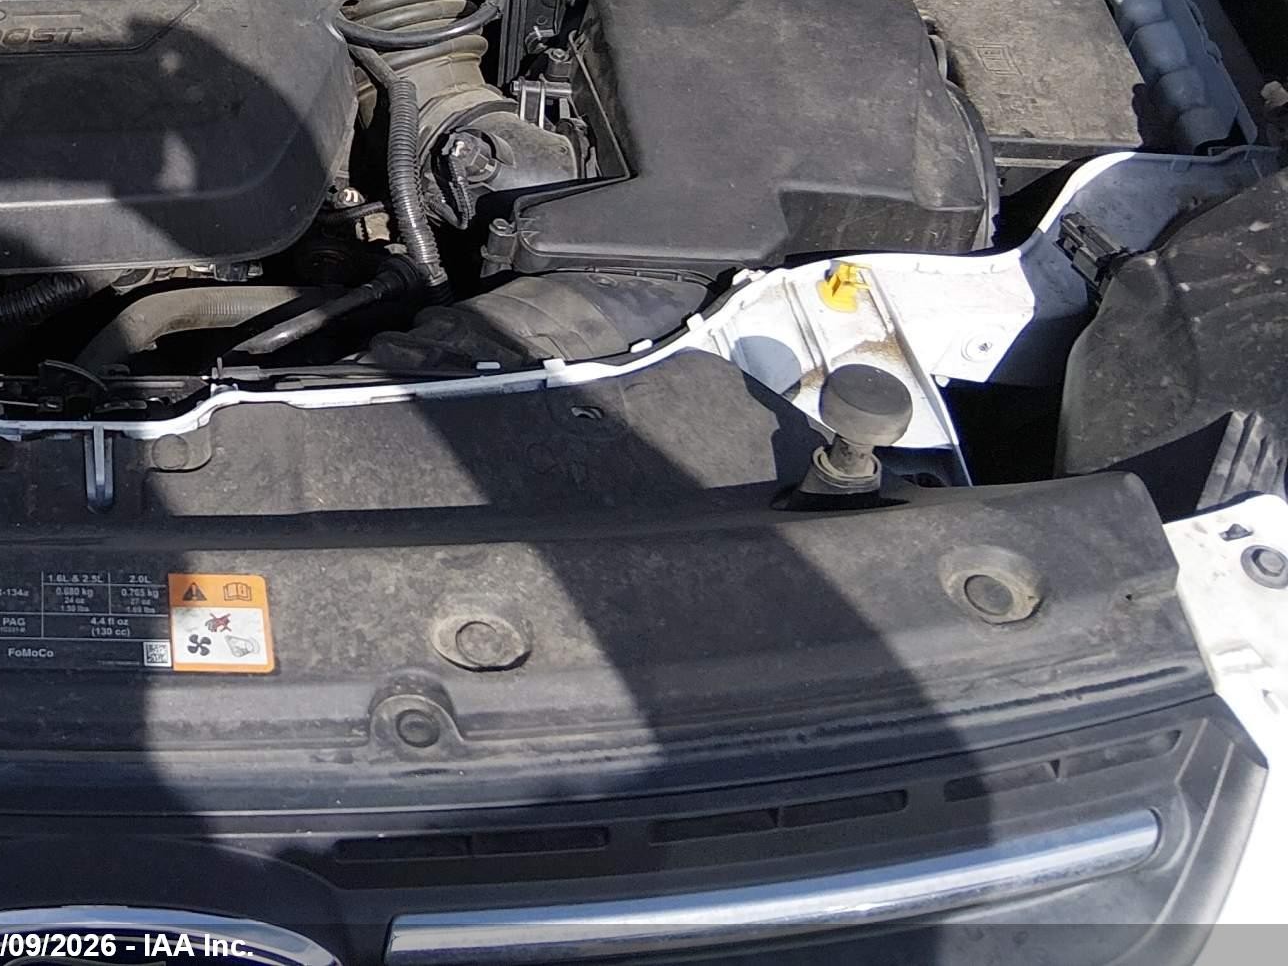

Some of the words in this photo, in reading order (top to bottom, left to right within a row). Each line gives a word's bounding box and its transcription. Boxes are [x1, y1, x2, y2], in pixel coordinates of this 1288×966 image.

[129, 575, 152, 583] 2.0L
[82, 587, 94, 598] kg
[147, 588, 159, 598] kg
[2, 617, 26, 626] PAG
[90, 617, 105, 625] 4.4
[107, 617, 115, 625] fl
[91, 627, 112, 637] (130
[114, 628, 130, 637] cc)
[8, 648, 54, 658] FoMoCo
